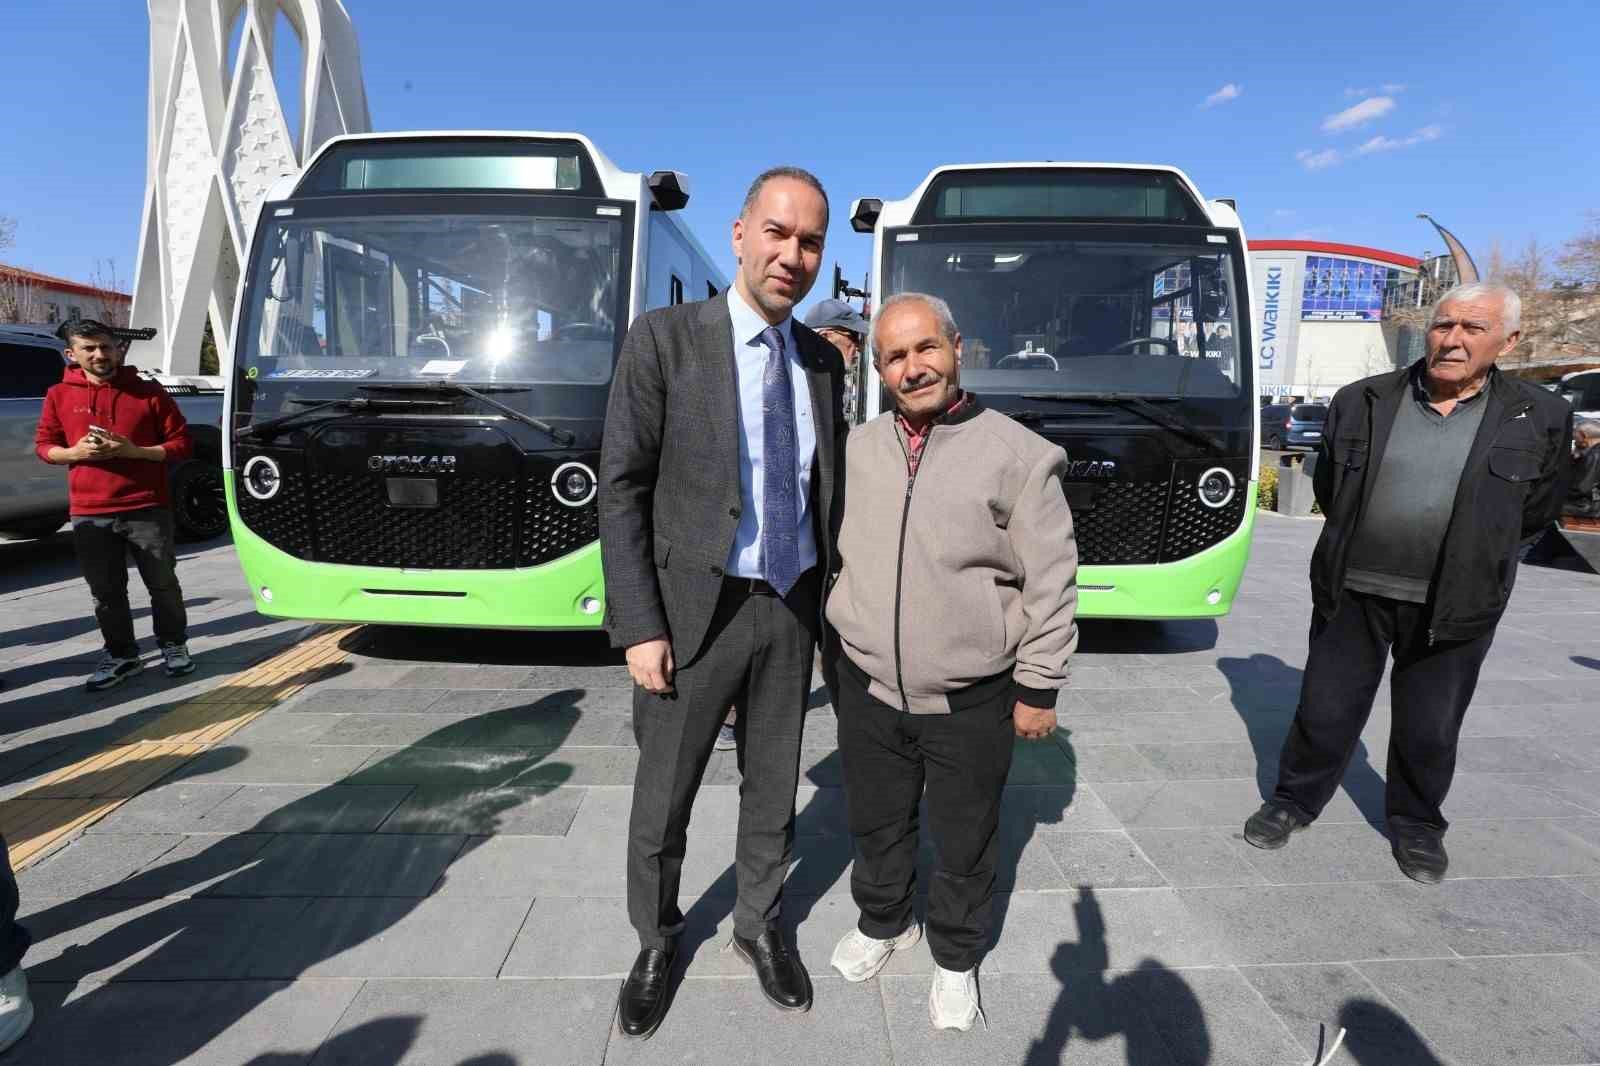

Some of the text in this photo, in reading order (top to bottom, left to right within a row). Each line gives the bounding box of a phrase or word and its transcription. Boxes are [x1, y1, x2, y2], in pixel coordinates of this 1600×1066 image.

[1260, 345, 1274, 370] LC
[1260, 385, 1292, 396] IKIKI
[368, 455, 457, 473] OTOKAR
[1069, 460, 1116, 477] KAR
